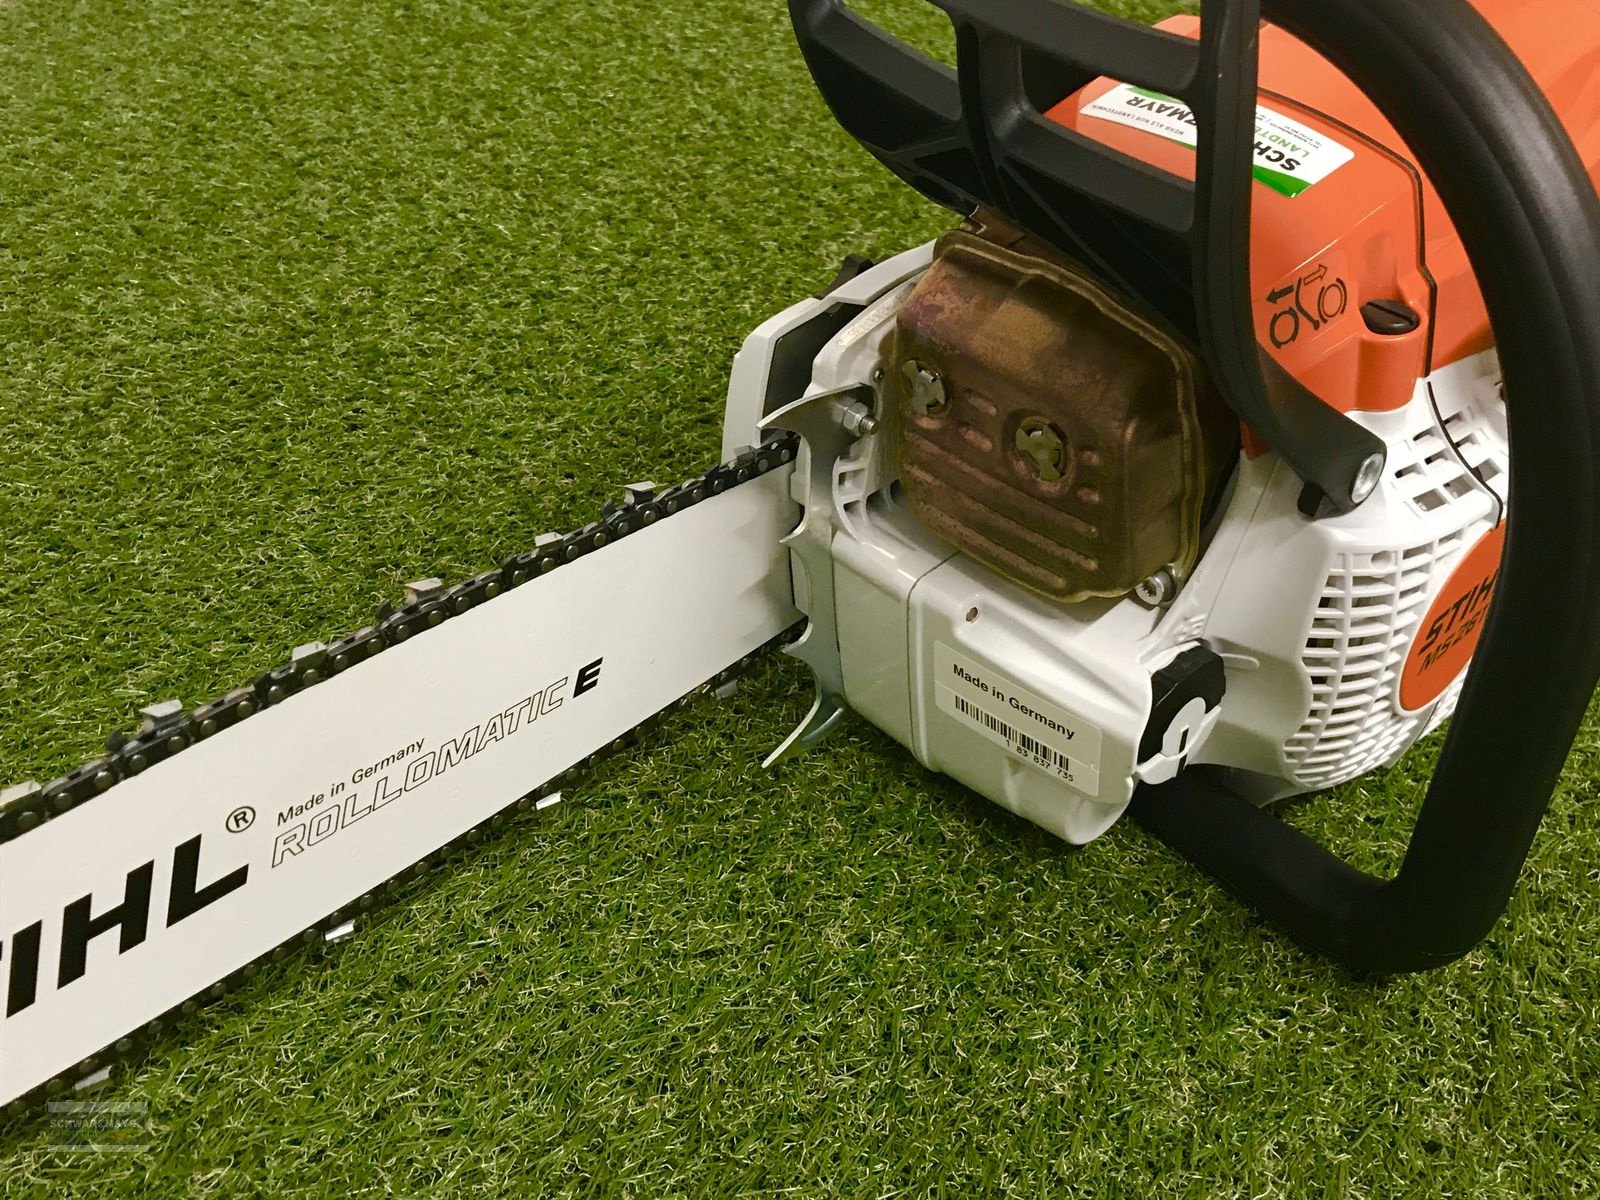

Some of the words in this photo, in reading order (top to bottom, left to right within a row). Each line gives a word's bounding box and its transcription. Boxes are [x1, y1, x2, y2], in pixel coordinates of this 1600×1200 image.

[1151, 120, 1165, 128] ALS
[1164, 126, 1185, 136] MEHR
[953, 663, 989, 692] Made
[992, 686, 1005, 702] in
[1008, 697, 1075, 740] Germany
[271, 676, 569, 869] ROLLOMATIC
[572, 656, 604, 699] E
[276, 792, 325, 826] Made
[330, 780, 346, 798] in
[352, 737, 425, 785] Germany
[1005, 739, 1011, 748] 1
[1016, 745, 1029, 757] 83
[1033, 755, 1051, 769] 837
[1056, 768, 1074, 782] 735
[0, 833, 249, 1018] IHL
